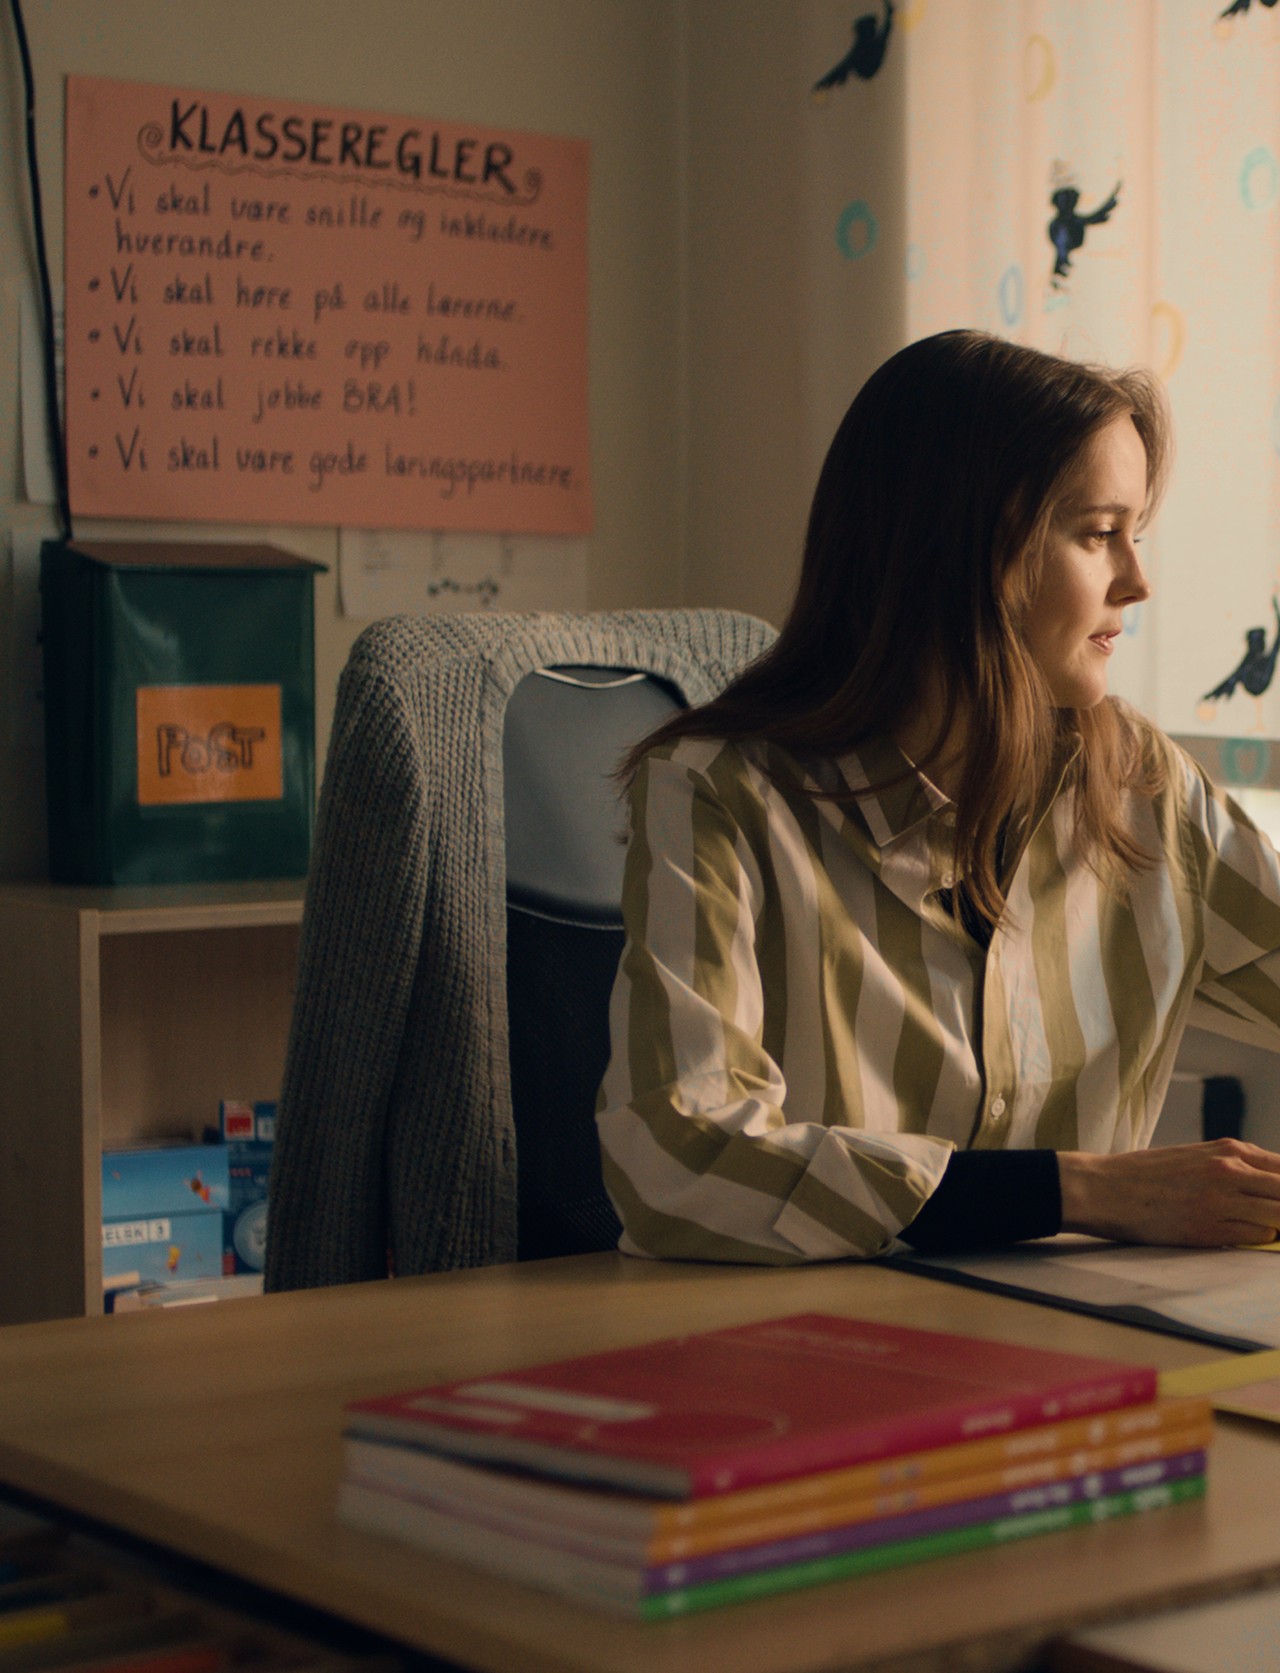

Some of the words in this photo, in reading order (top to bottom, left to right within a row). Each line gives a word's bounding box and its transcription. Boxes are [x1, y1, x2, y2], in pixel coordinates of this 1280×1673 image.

[170, 98, 518, 194] KLASSEREGLER
[106, 166, 136, 215] Vi
[156, 183, 210, 214] skal
[305, 197, 382, 228] snille
[397, 207, 426, 243] og
[110, 263, 138, 304] Vi
[164, 275, 212, 304] skal
[314, 282, 346, 323] på
[363, 281, 410, 314] alle
[113, 316, 143, 355] Vi
[169, 321, 223, 356] skal
[251, 327, 317, 359] rekke
[344, 339, 391, 371] opp
[117, 366, 145, 409] Vi
[171, 377, 224, 410] skal
[252, 376, 323, 423] jobbe
[343, 378, 416, 417] BRA!
[115, 426, 148, 472] Vi
[167, 435, 219, 472] skal
[308, 441, 367, 492] gode
